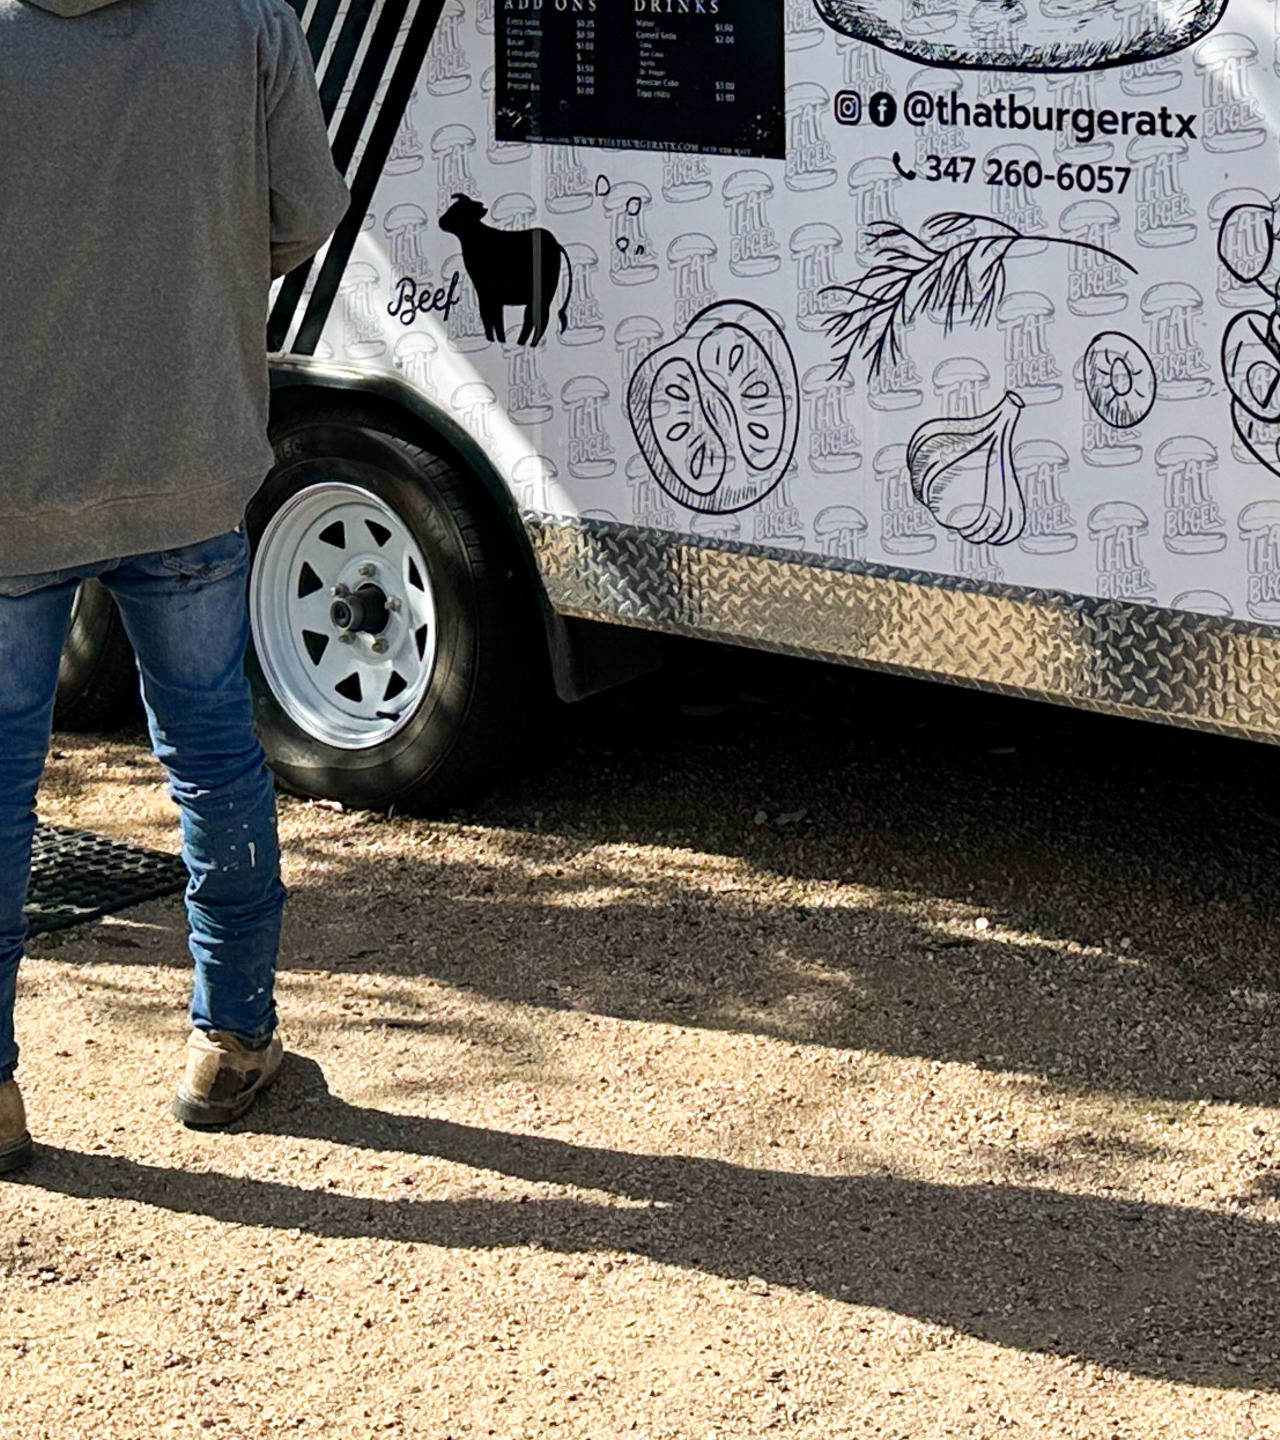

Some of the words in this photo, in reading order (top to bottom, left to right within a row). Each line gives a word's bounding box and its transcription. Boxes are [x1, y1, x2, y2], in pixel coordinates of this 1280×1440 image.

[904, 92, 1198, 143] @thatburgeratx
[925, 155, 977, 184] 347
[986, 158, 1131, 195] 260-6057
[387, 270, 460, 326] Beef
